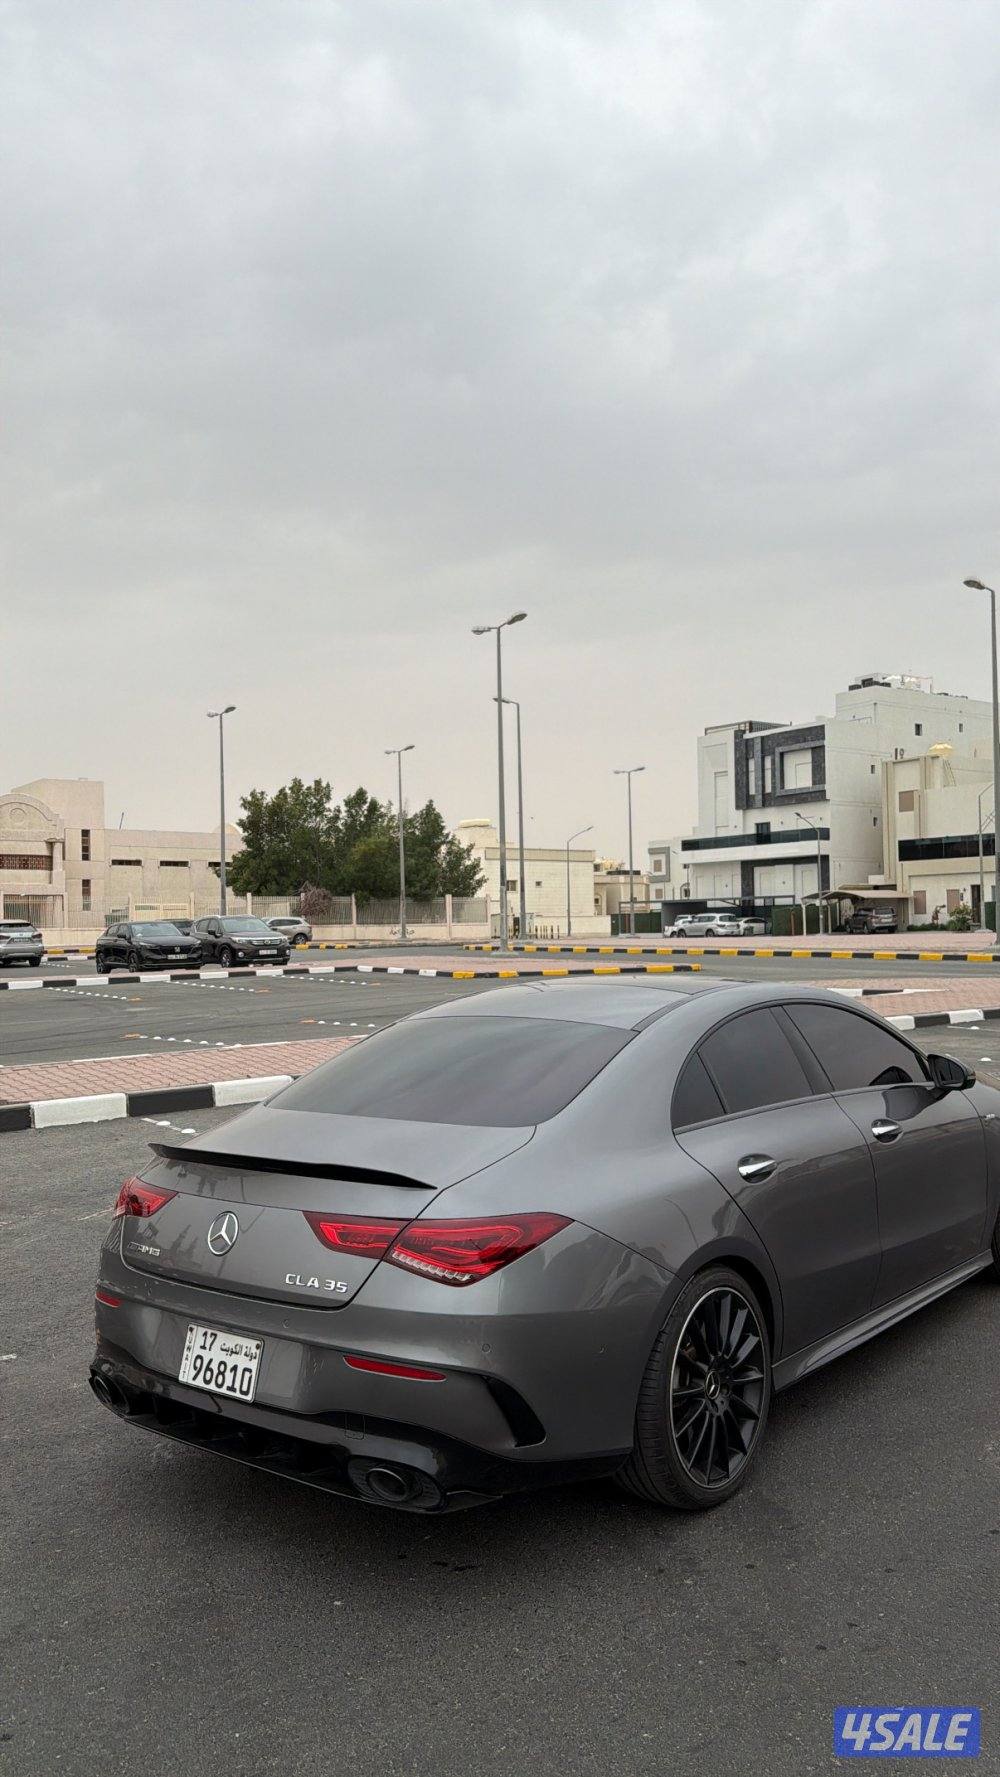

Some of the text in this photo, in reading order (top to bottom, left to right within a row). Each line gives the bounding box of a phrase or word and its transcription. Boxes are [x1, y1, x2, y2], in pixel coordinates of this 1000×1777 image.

[285, 1273, 348, 1293] CLA 35
[199, 1330, 218, 1351] 17
[220, 1342, 258, 1362] دولة الكويت
[192, 1354, 253, 1397] 96810
